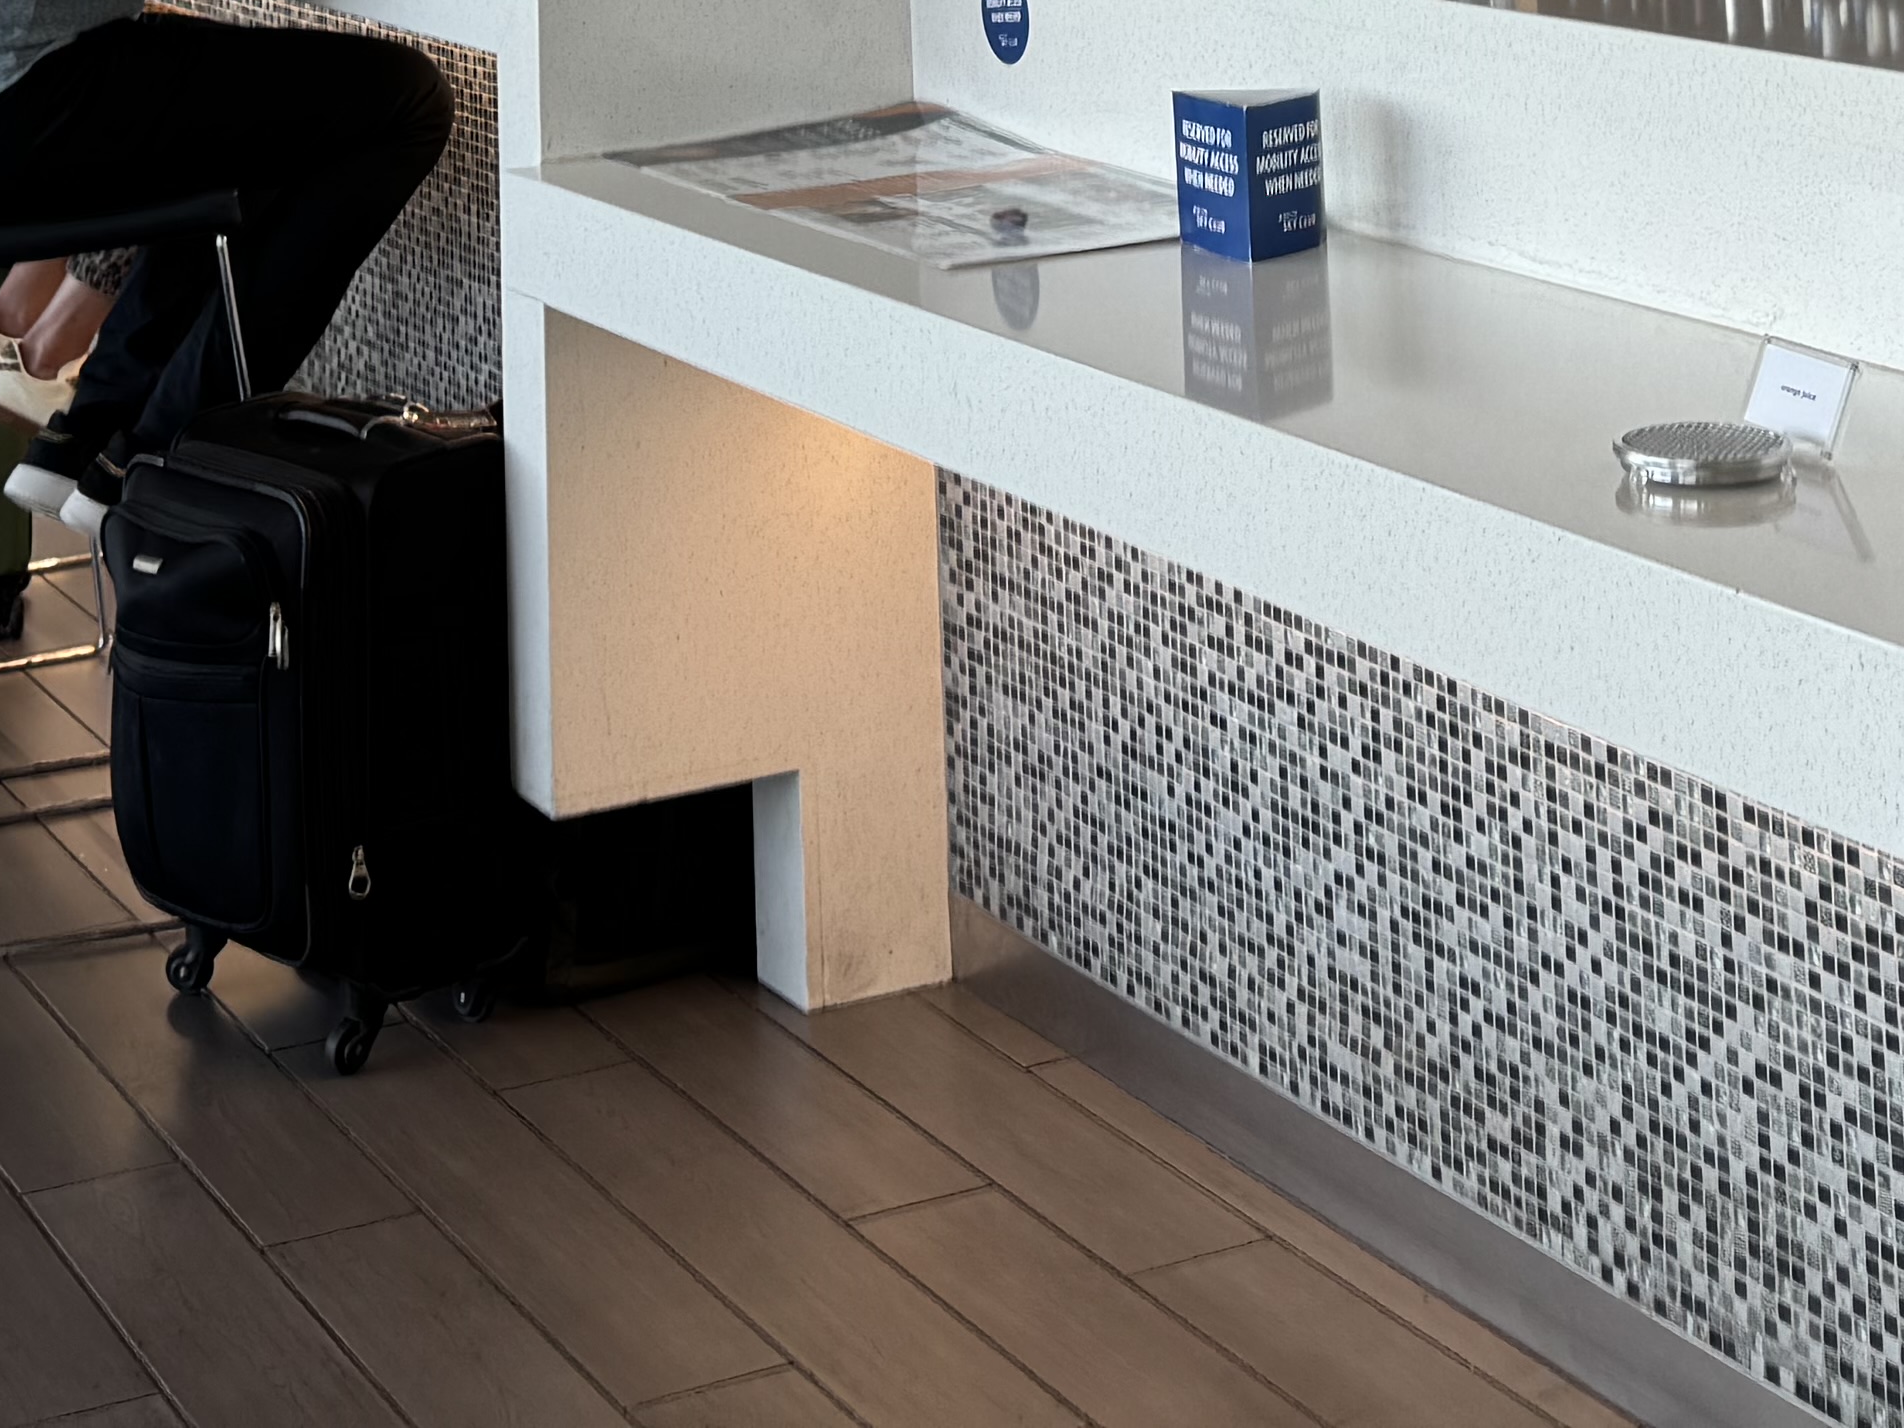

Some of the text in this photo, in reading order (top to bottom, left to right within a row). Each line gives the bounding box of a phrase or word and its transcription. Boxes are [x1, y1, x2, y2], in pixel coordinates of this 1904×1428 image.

[1182, 119, 1232, 149] RESERVED FOR
[1262, 123, 1306, 150] RESERVED
[1209, 149, 1239, 176] ACCESS
[1256, 148, 1298, 175] MOBILITY
[1184, 166, 1235, 198] WHEN NEEDED
[1264, 171, 1293, 197] WHEN
